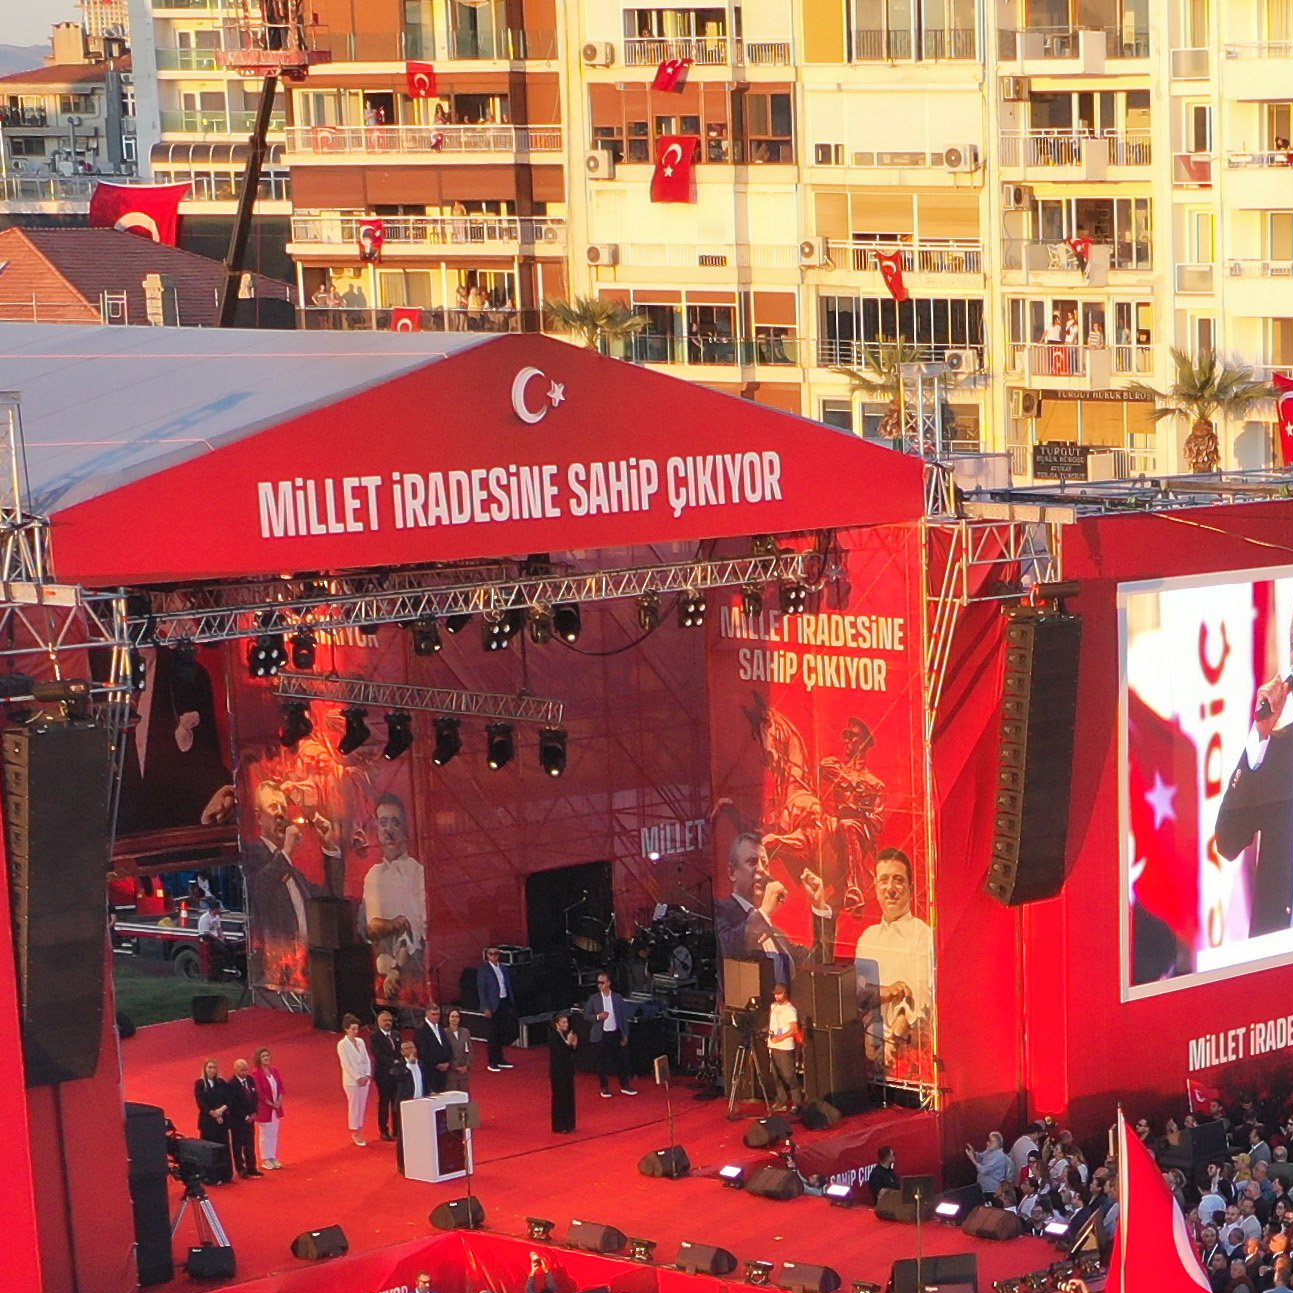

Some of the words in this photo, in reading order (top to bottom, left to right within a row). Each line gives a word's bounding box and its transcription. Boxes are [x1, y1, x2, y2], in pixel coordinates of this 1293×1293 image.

[1039, 446, 1081, 456] TURGUT
[257, 476, 382, 539] MİLLET
[392, 464, 561, 530] İRADESİNE
[567, 456, 659, 518] SAHİP
[668, 450, 783, 518] ÇIKIYOR
[797, 614, 905, 651] İRADESİNE
[738, 647, 798, 684] SAHİP
[802, 653, 887, 692] ÇIKIYOR
[640, 818, 706, 858] MİLLET
[1188, 1026, 1247, 1072] MİLLET
